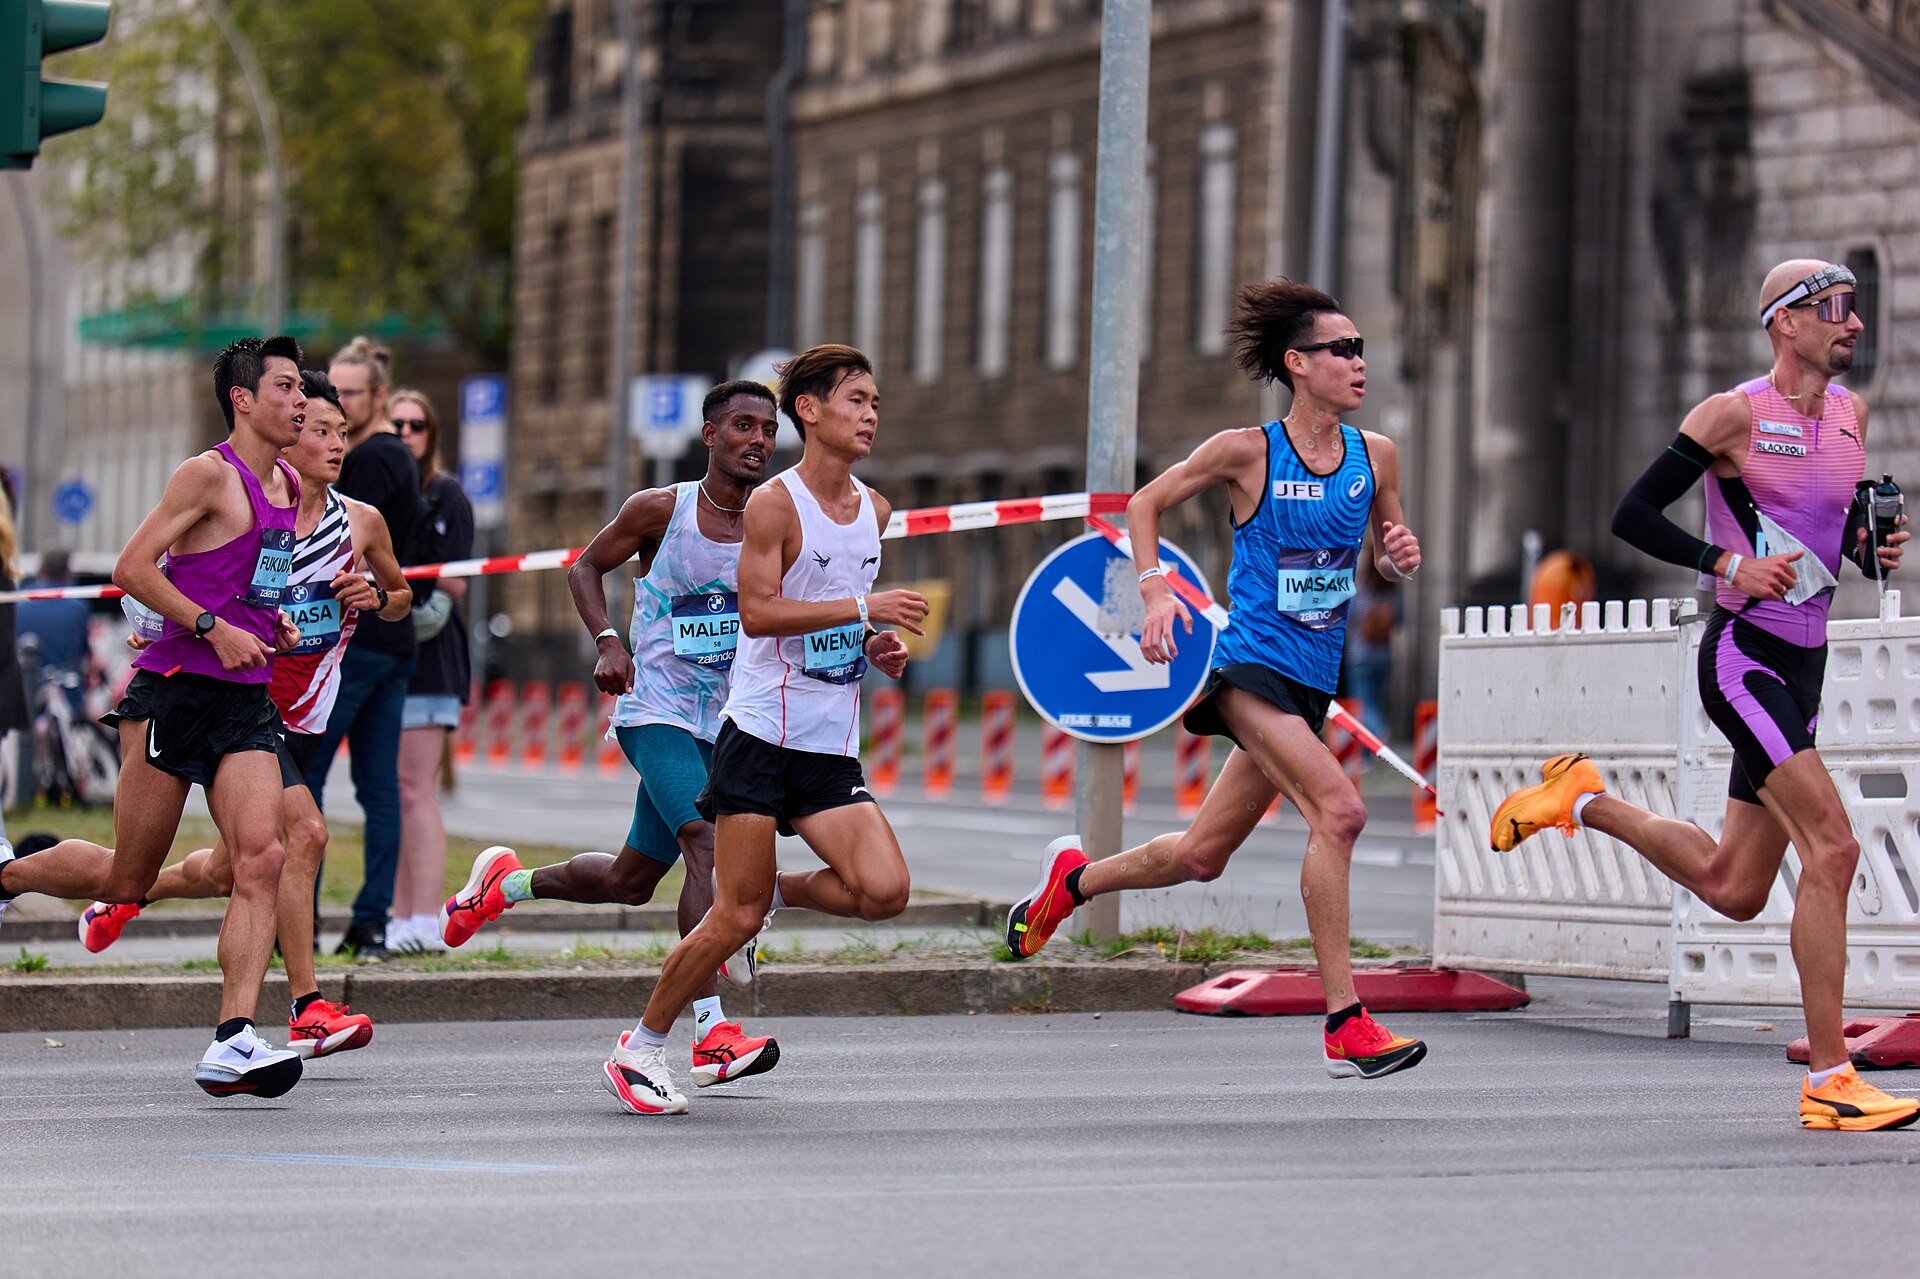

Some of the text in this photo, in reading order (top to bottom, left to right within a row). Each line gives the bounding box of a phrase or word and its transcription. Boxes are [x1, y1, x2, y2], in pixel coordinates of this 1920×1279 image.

[1757, 442, 1805, 456] BLACKROLL
[1276, 483, 1322, 498] JFE
[1286, 576, 1350, 593] IWASAKI
[697, 650, 734, 664] zalando
